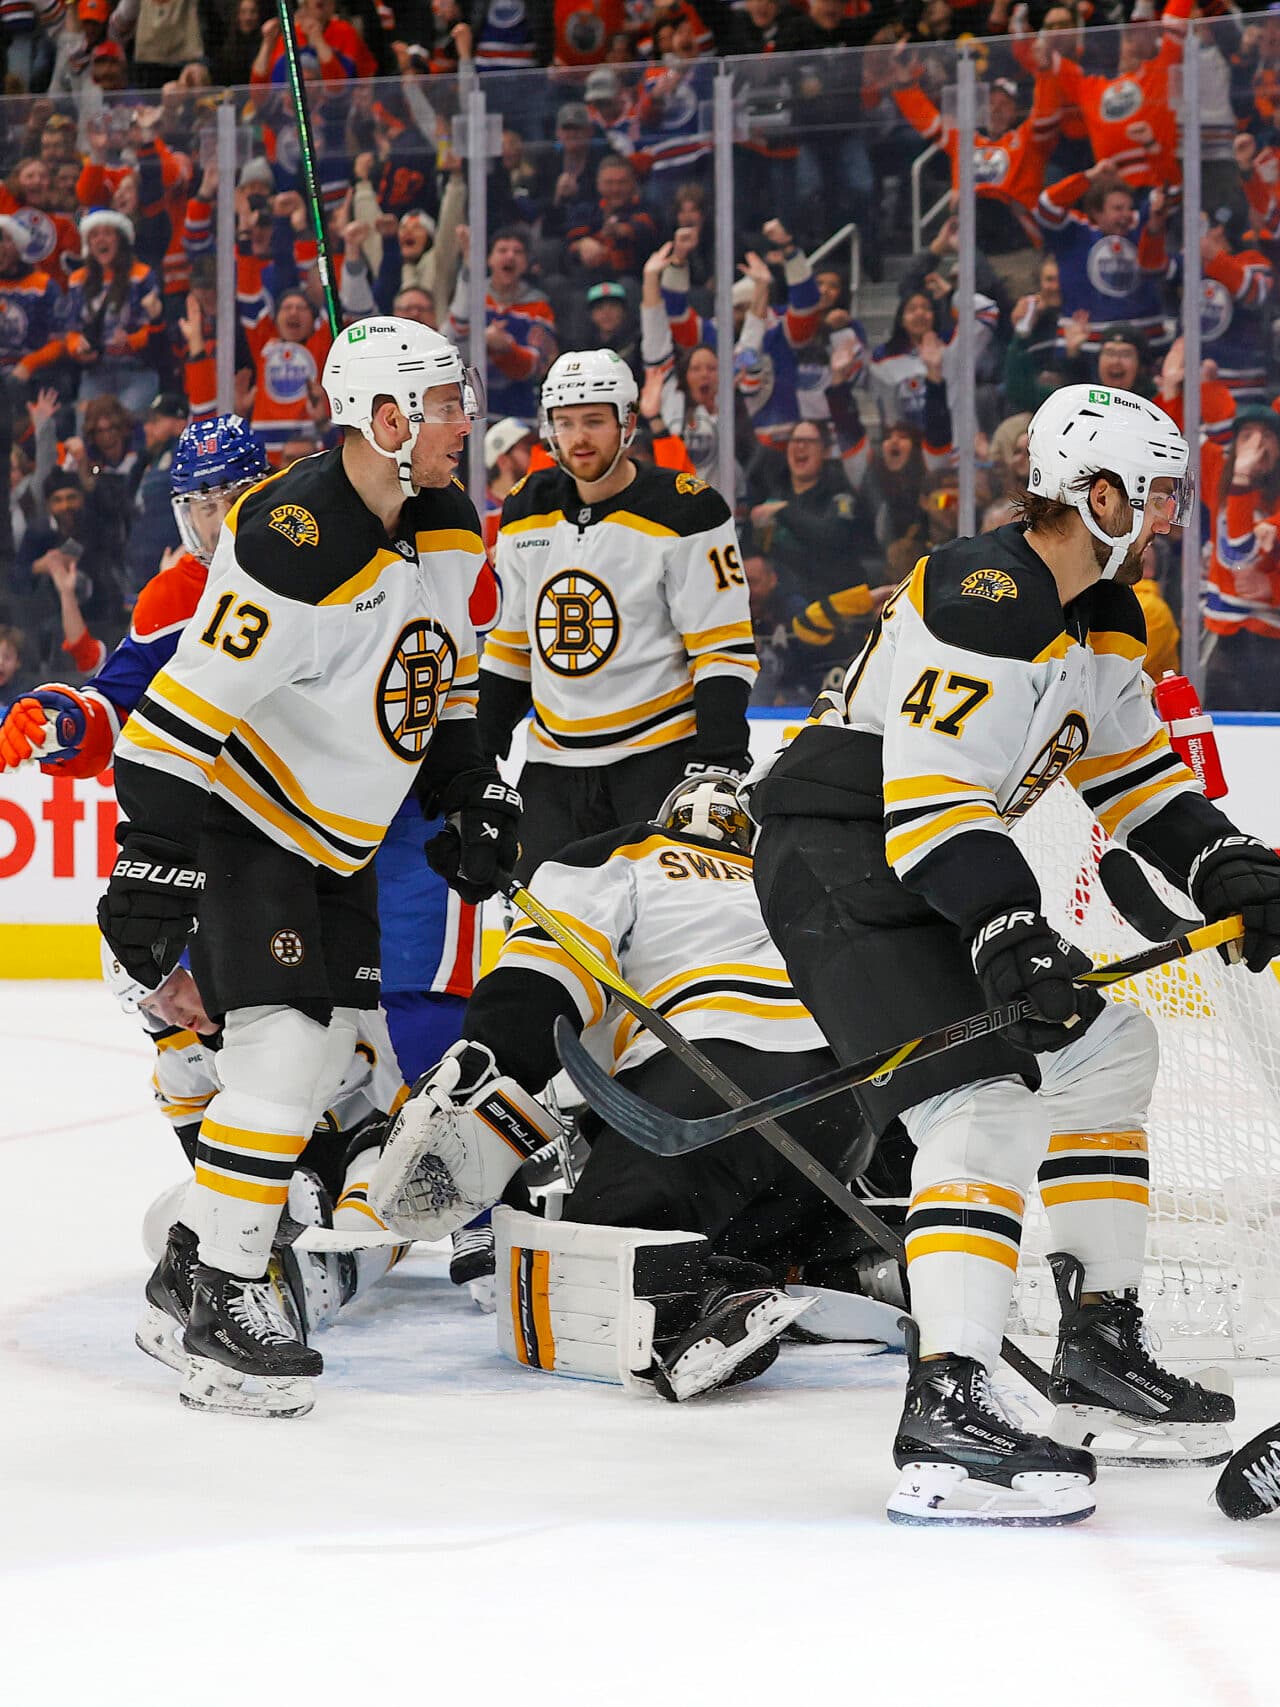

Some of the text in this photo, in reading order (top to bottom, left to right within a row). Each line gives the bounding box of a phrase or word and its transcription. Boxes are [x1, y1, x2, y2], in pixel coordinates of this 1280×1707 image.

[1113, 396, 1142, 411] Bank
[273, 506, 319, 546] BOSTON
[962, 570, 1017, 598] BOSTON
[198, 590, 272, 662] 13
[899, 666, 994, 740] 47
[112, 860, 207, 890] BAUER
[486, 1101, 537, 1151] TRUE
[1124, 1370, 1174, 1402] BAUER
[963, 1423, 1018, 1450] BAUER
